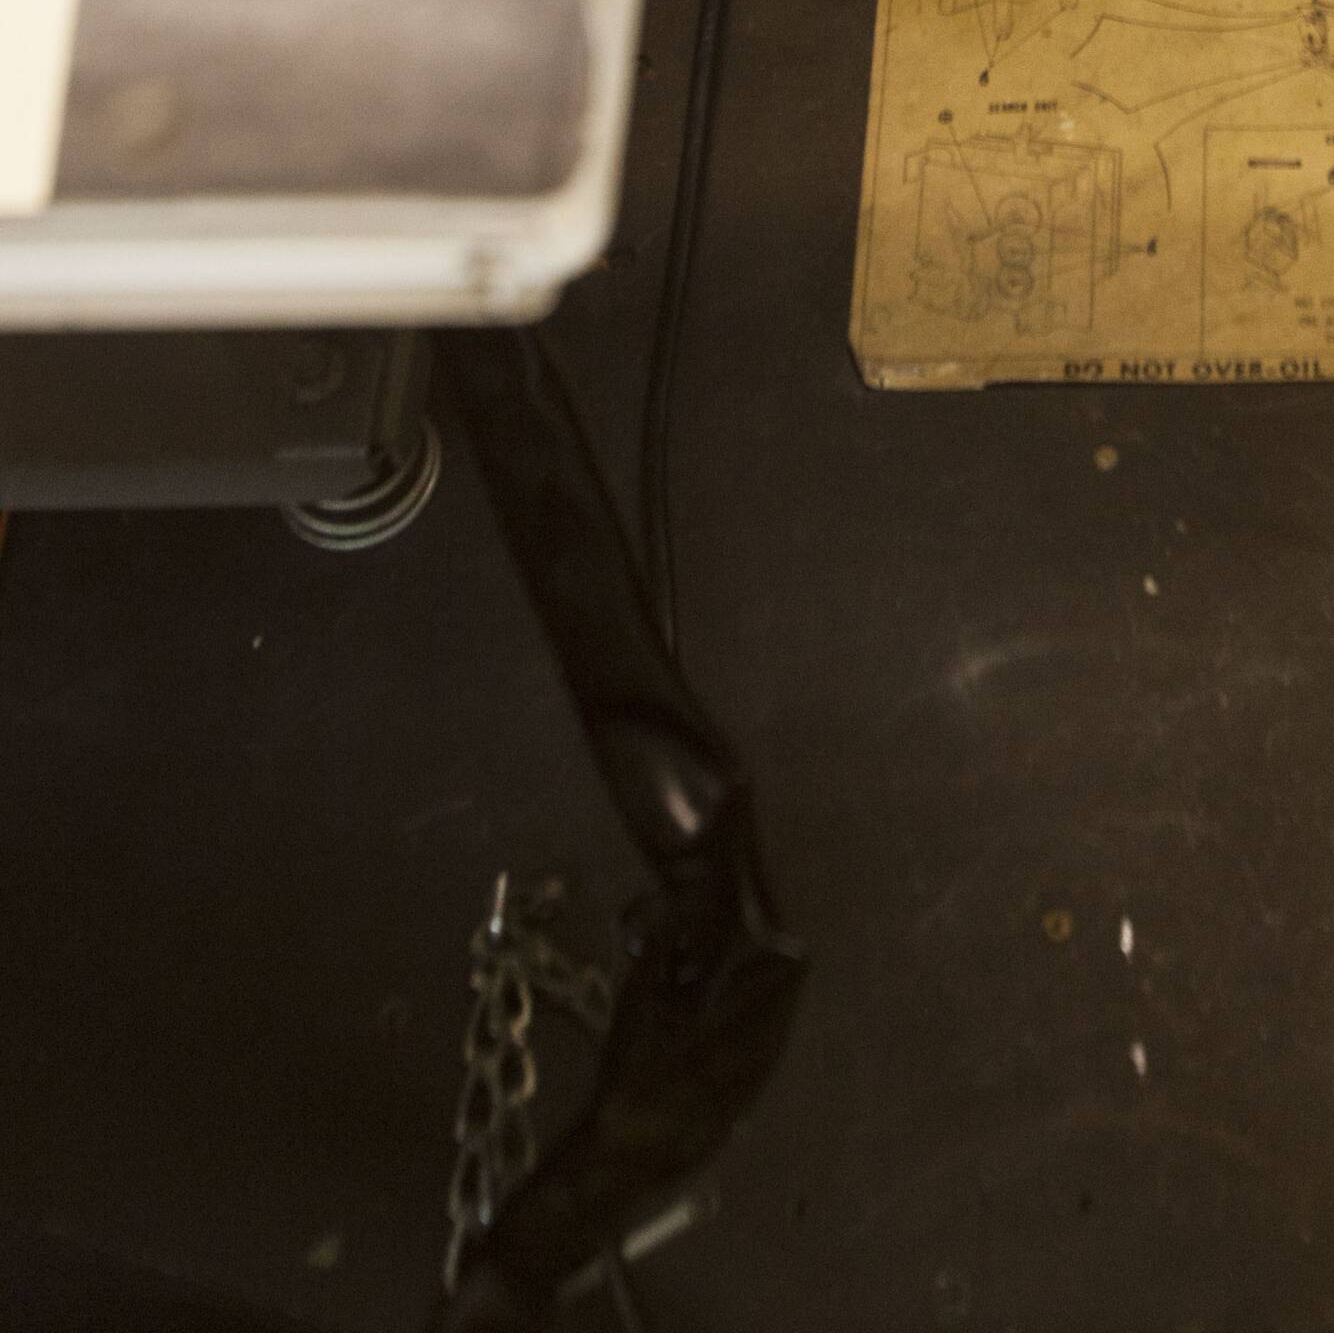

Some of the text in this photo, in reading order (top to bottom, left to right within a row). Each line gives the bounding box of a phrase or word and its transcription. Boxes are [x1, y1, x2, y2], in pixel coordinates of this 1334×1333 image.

[1063, 358, 1103, 381] DO
[1120, 358, 1176, 381] NOT
[1279, 357, 1327, 381] OIL
